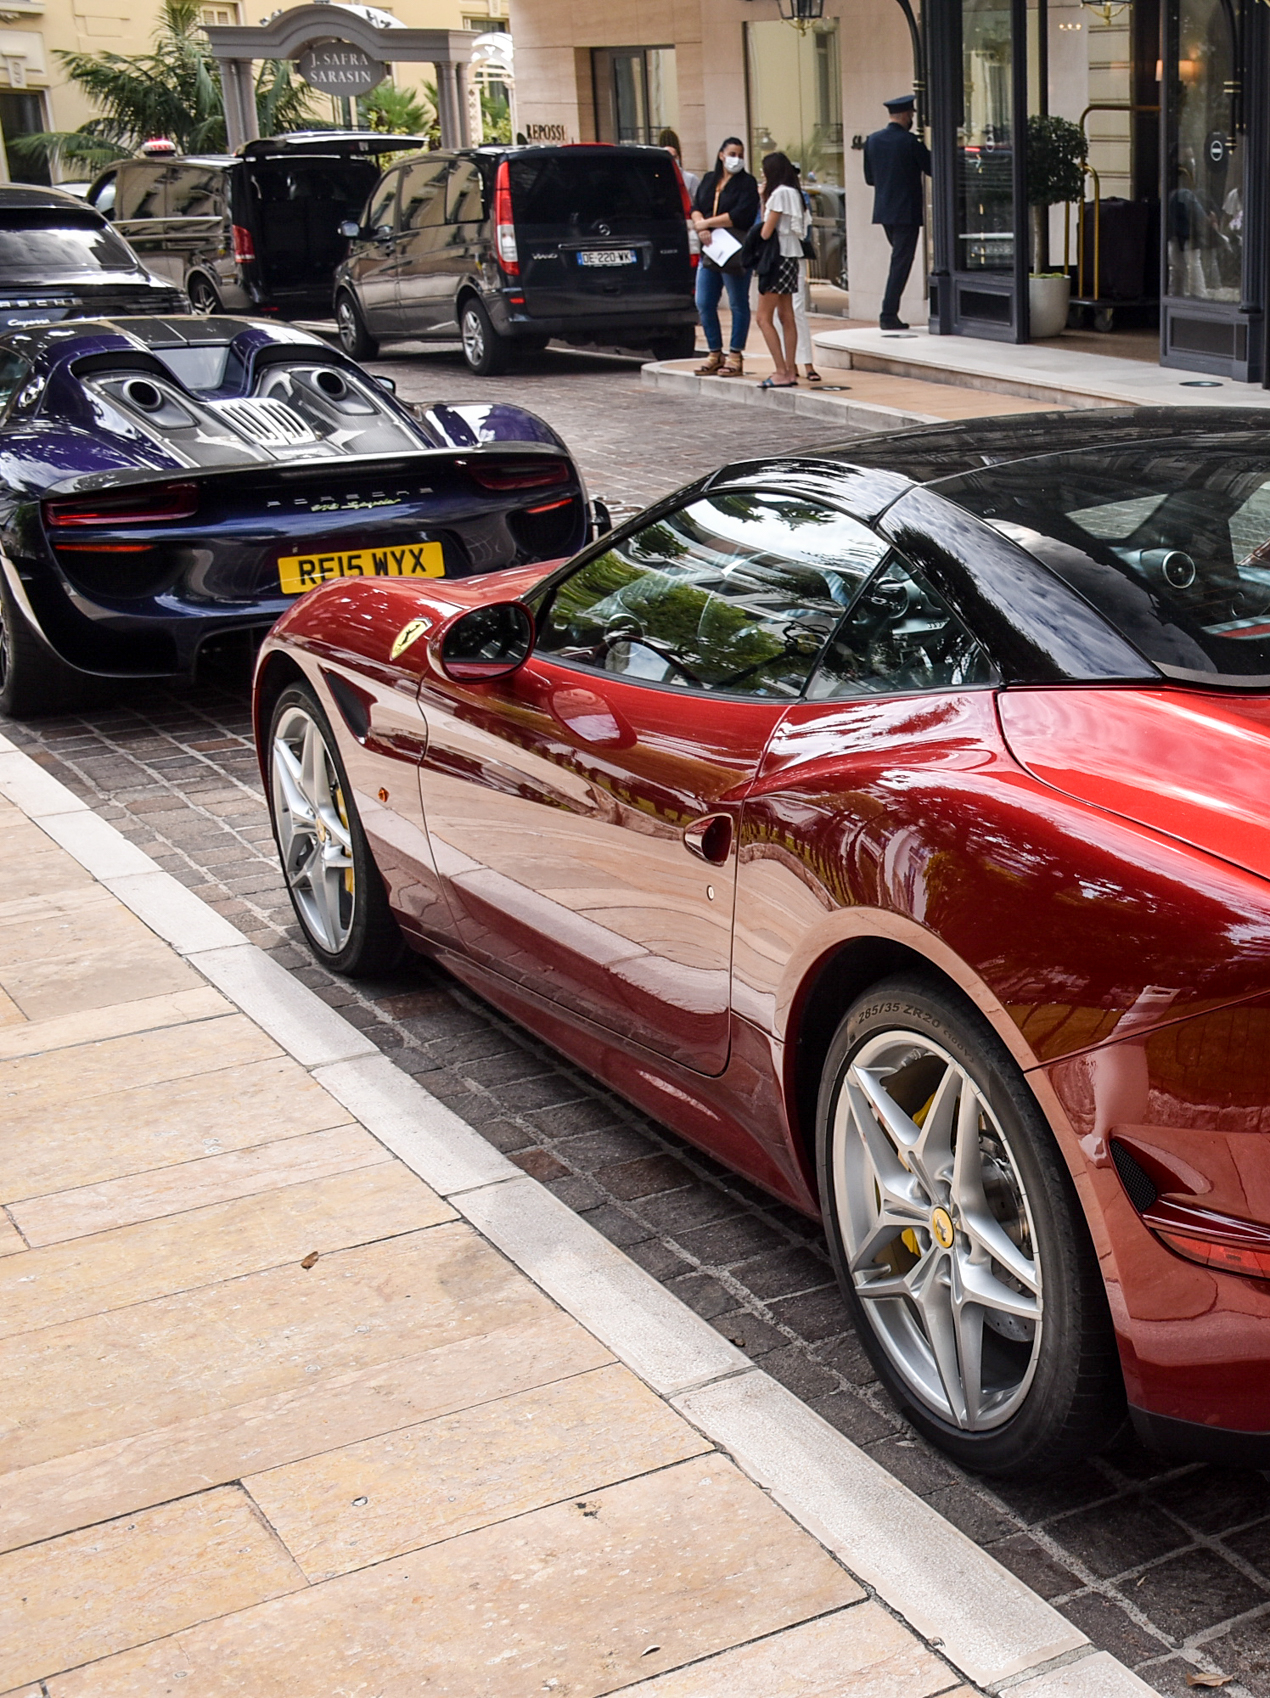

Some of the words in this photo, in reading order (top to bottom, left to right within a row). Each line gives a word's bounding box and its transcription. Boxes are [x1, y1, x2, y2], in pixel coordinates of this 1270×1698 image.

[311, 53, 320, 68] J.
[323, 53, 368, 66] SAFRA
[310, 70, 371, 83] SARASIN
[526, 124, 566, 141] REPOSSI
[267, 487, 434, 507] PORSCHE
[372, 548, 427, 577] WYX
[858, 1002, 901, 1025] 285/35
[903, 1004, 941, 1029] ZR20
